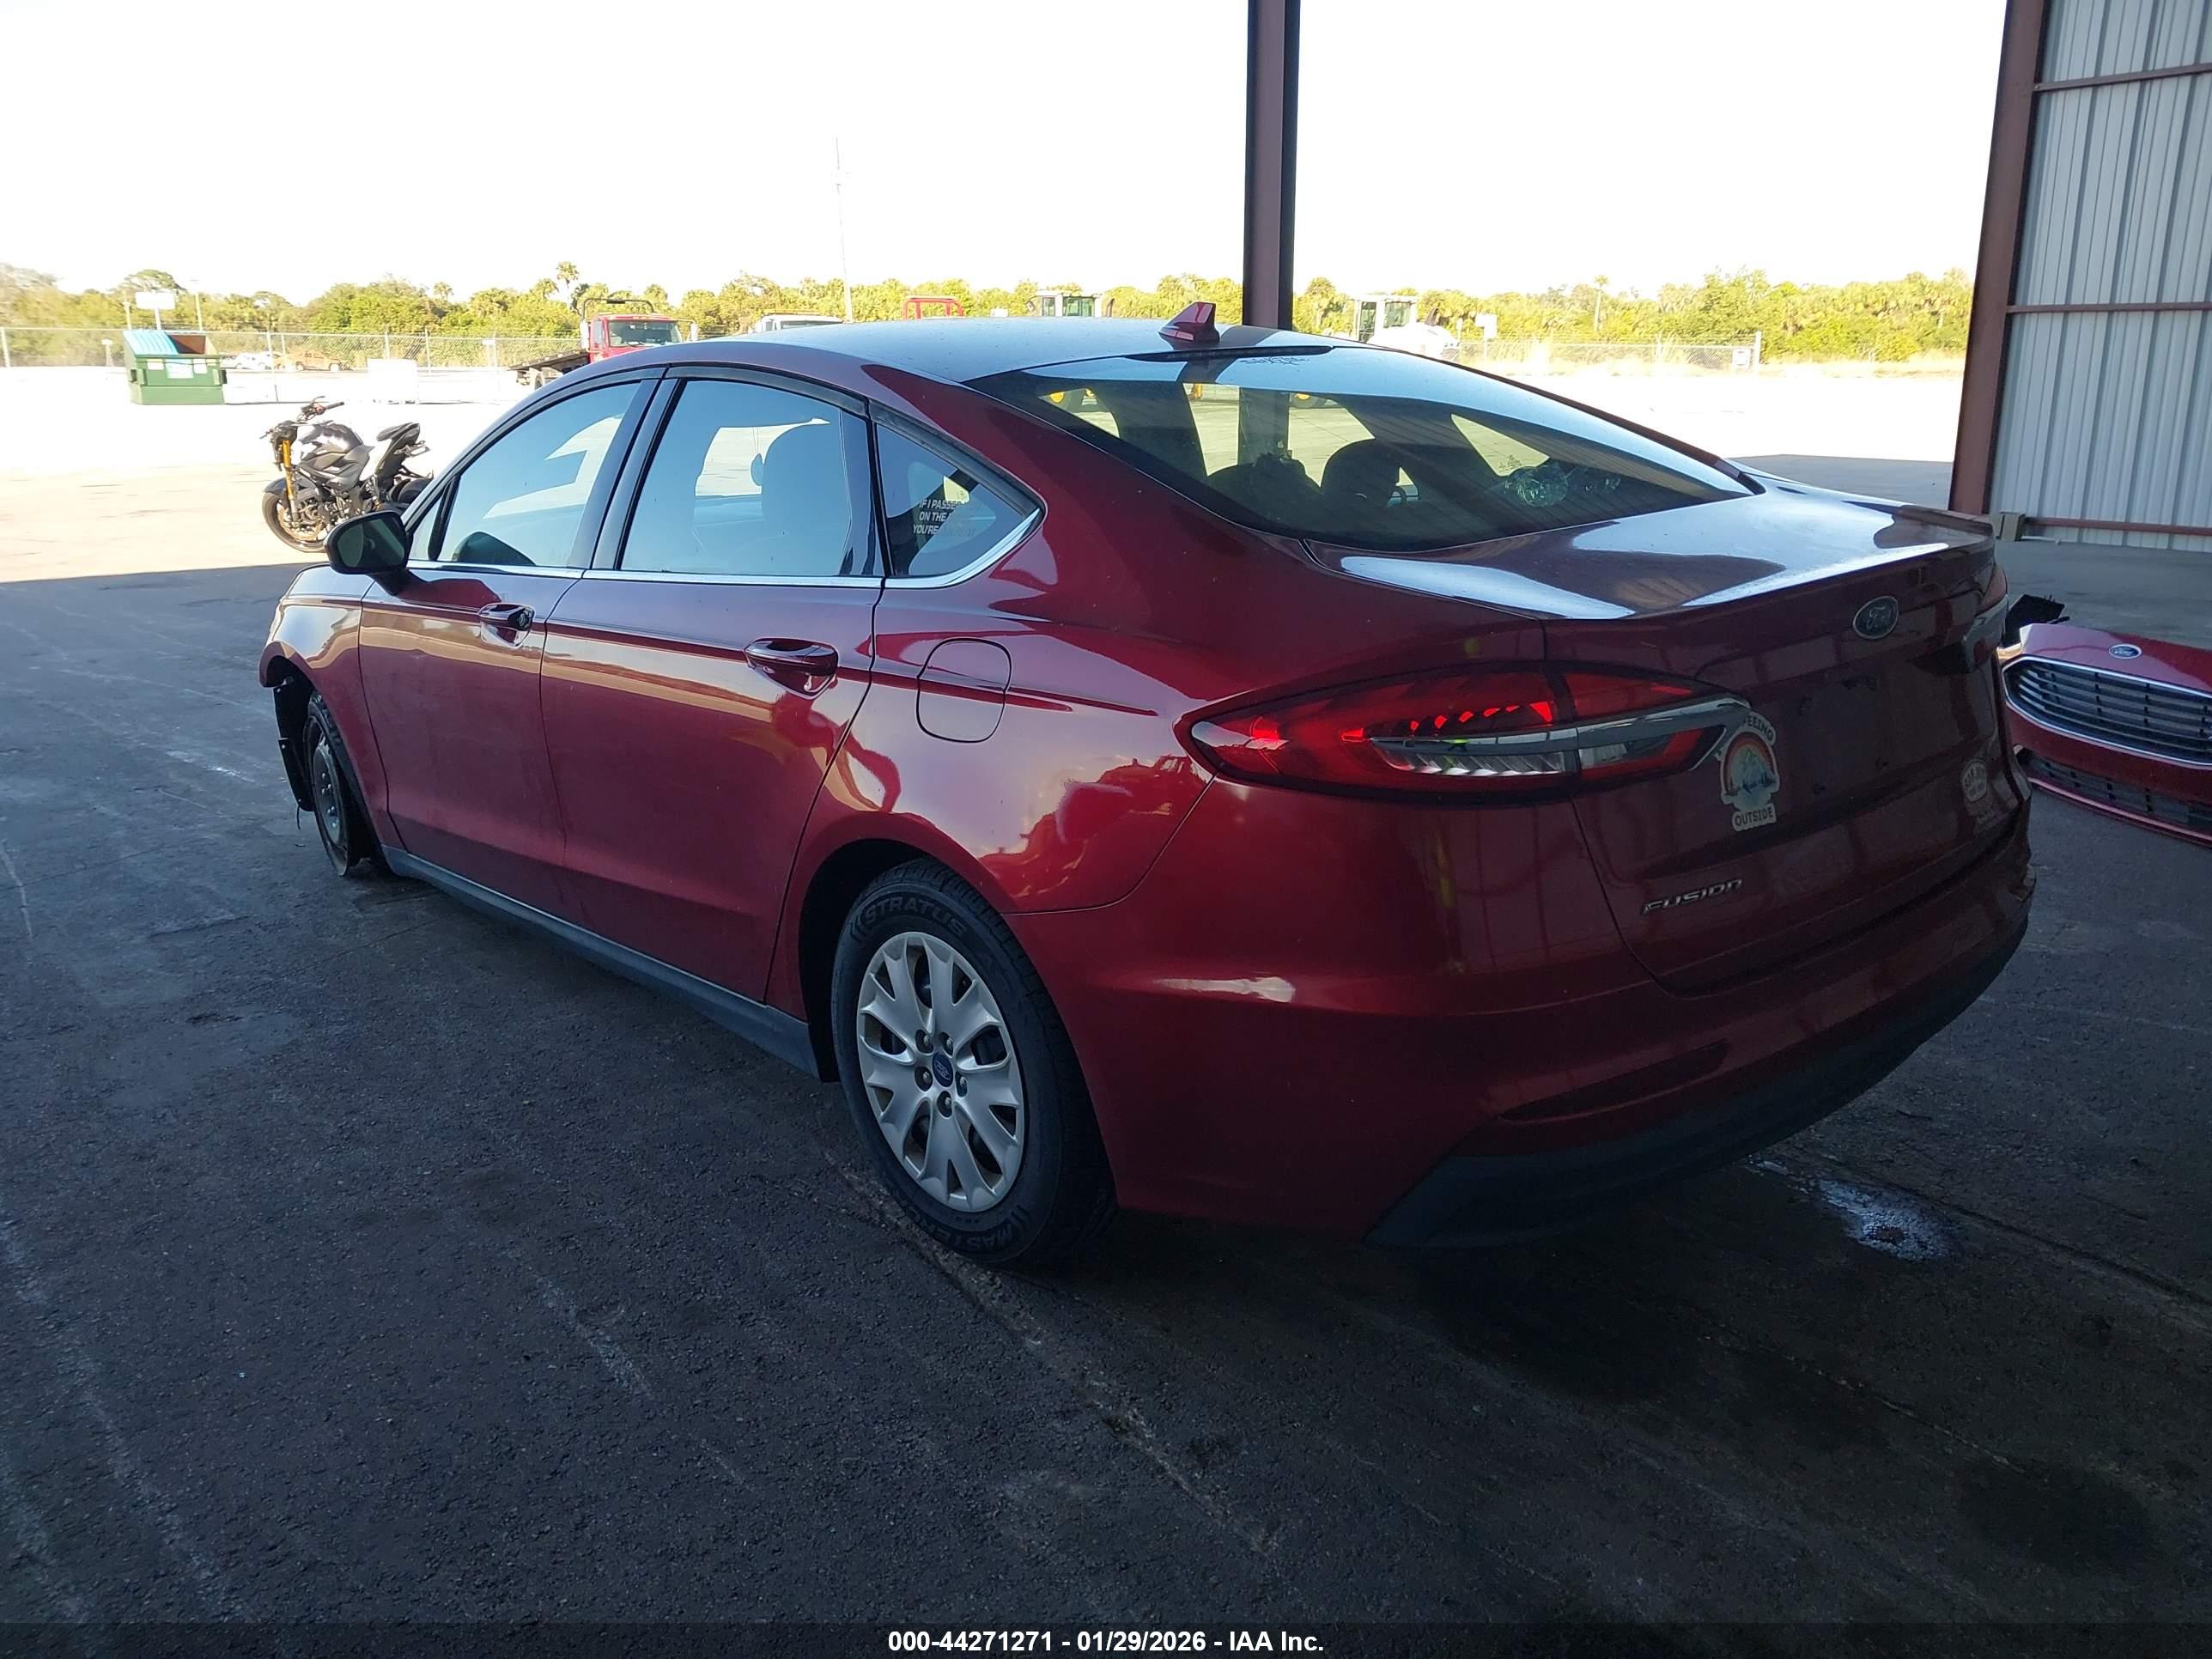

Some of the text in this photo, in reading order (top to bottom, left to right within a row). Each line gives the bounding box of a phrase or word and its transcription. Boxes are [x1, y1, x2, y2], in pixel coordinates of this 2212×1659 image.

[919, 499, 927, 508] IF
[919, 512, 929, 521] ON
[932, 512, 947, 521] THE
[913, 524, 939, 534] YOU'RE
[1734, 806, 1774, 827] OUTSIDE
[865, 896, 968, 937] STRATUS
